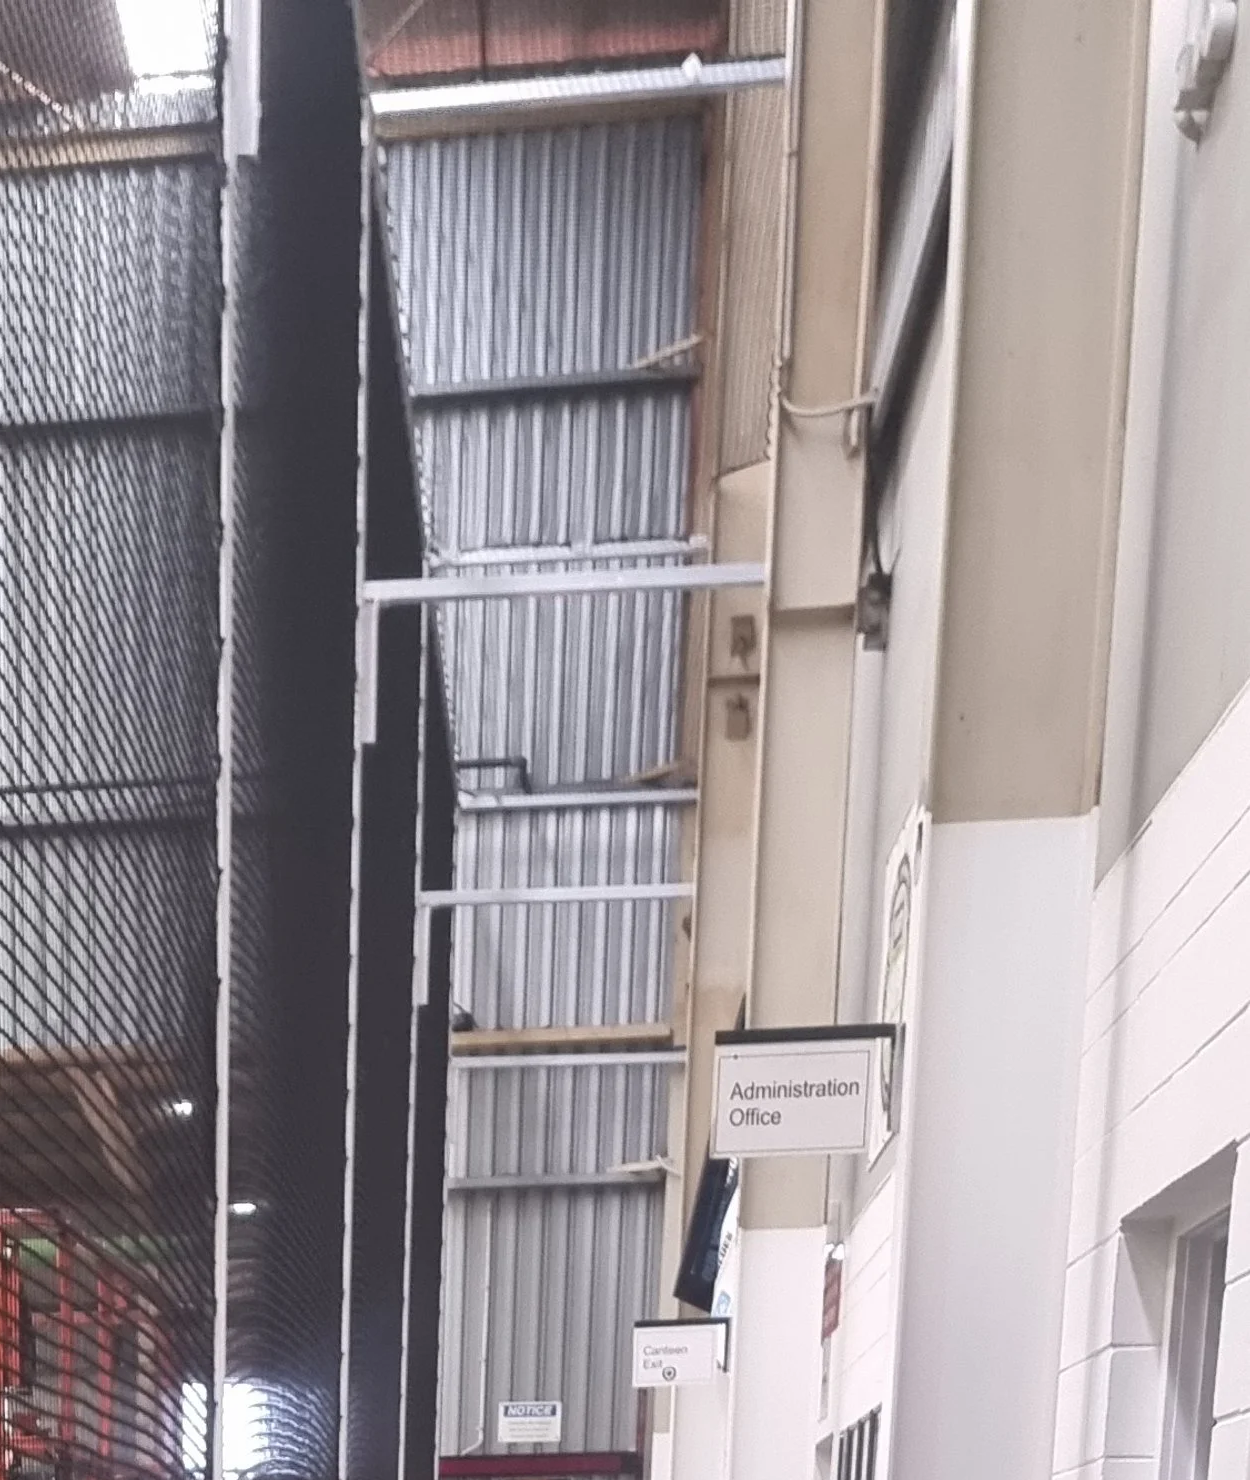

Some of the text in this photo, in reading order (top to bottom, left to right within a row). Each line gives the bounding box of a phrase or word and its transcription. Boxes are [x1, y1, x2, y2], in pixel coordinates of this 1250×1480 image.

[730, 1079, 860, 1100] Administration
[729, 1107, 781, 1127] Office
[643, 1345, 688, 1356] Canteen
[507, 1404, 553, 1416] NOTICE
